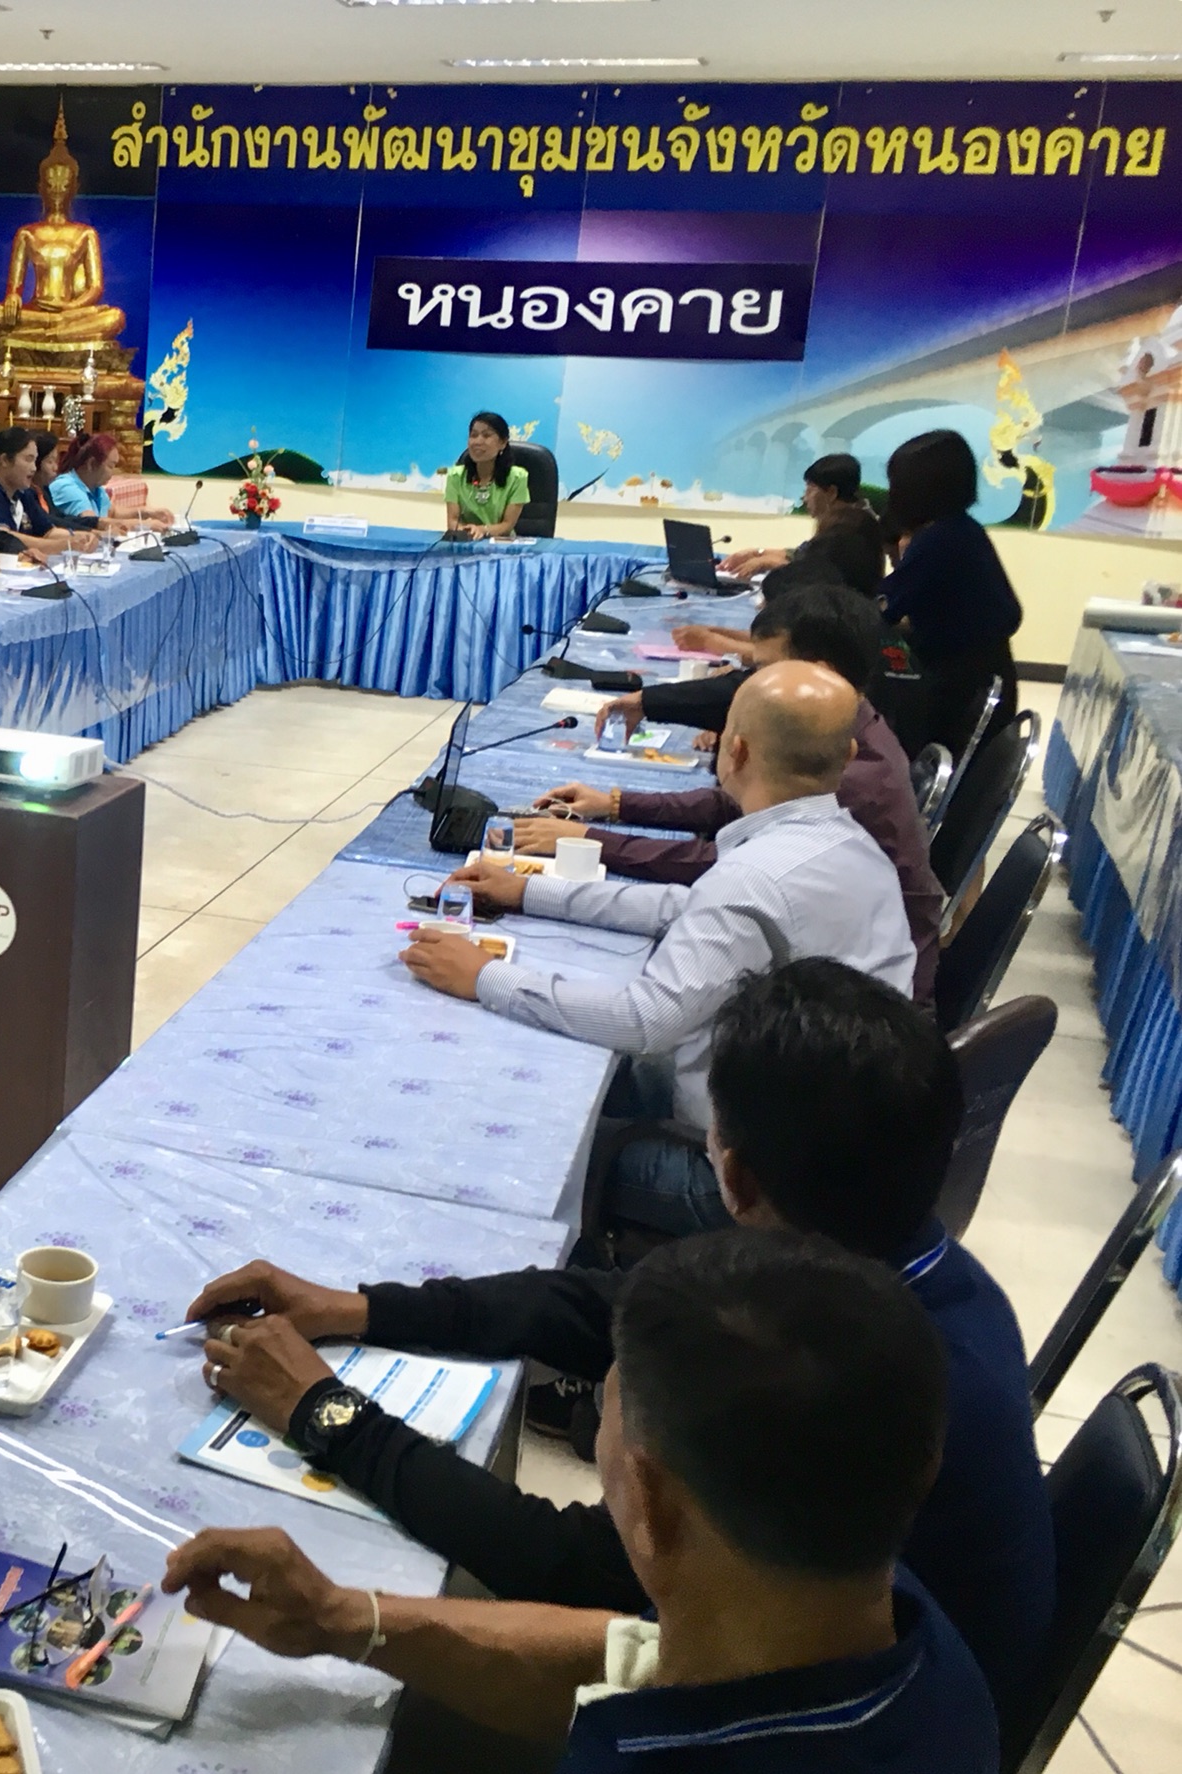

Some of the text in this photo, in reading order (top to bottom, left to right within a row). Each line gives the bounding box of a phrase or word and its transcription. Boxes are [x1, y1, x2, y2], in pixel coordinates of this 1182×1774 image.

[111, 100, 1167, 198] สำนักงานพัฒนาชุมชนจังหวัดหนองคาย
[397, 282, 785, 336] หนองคาย
